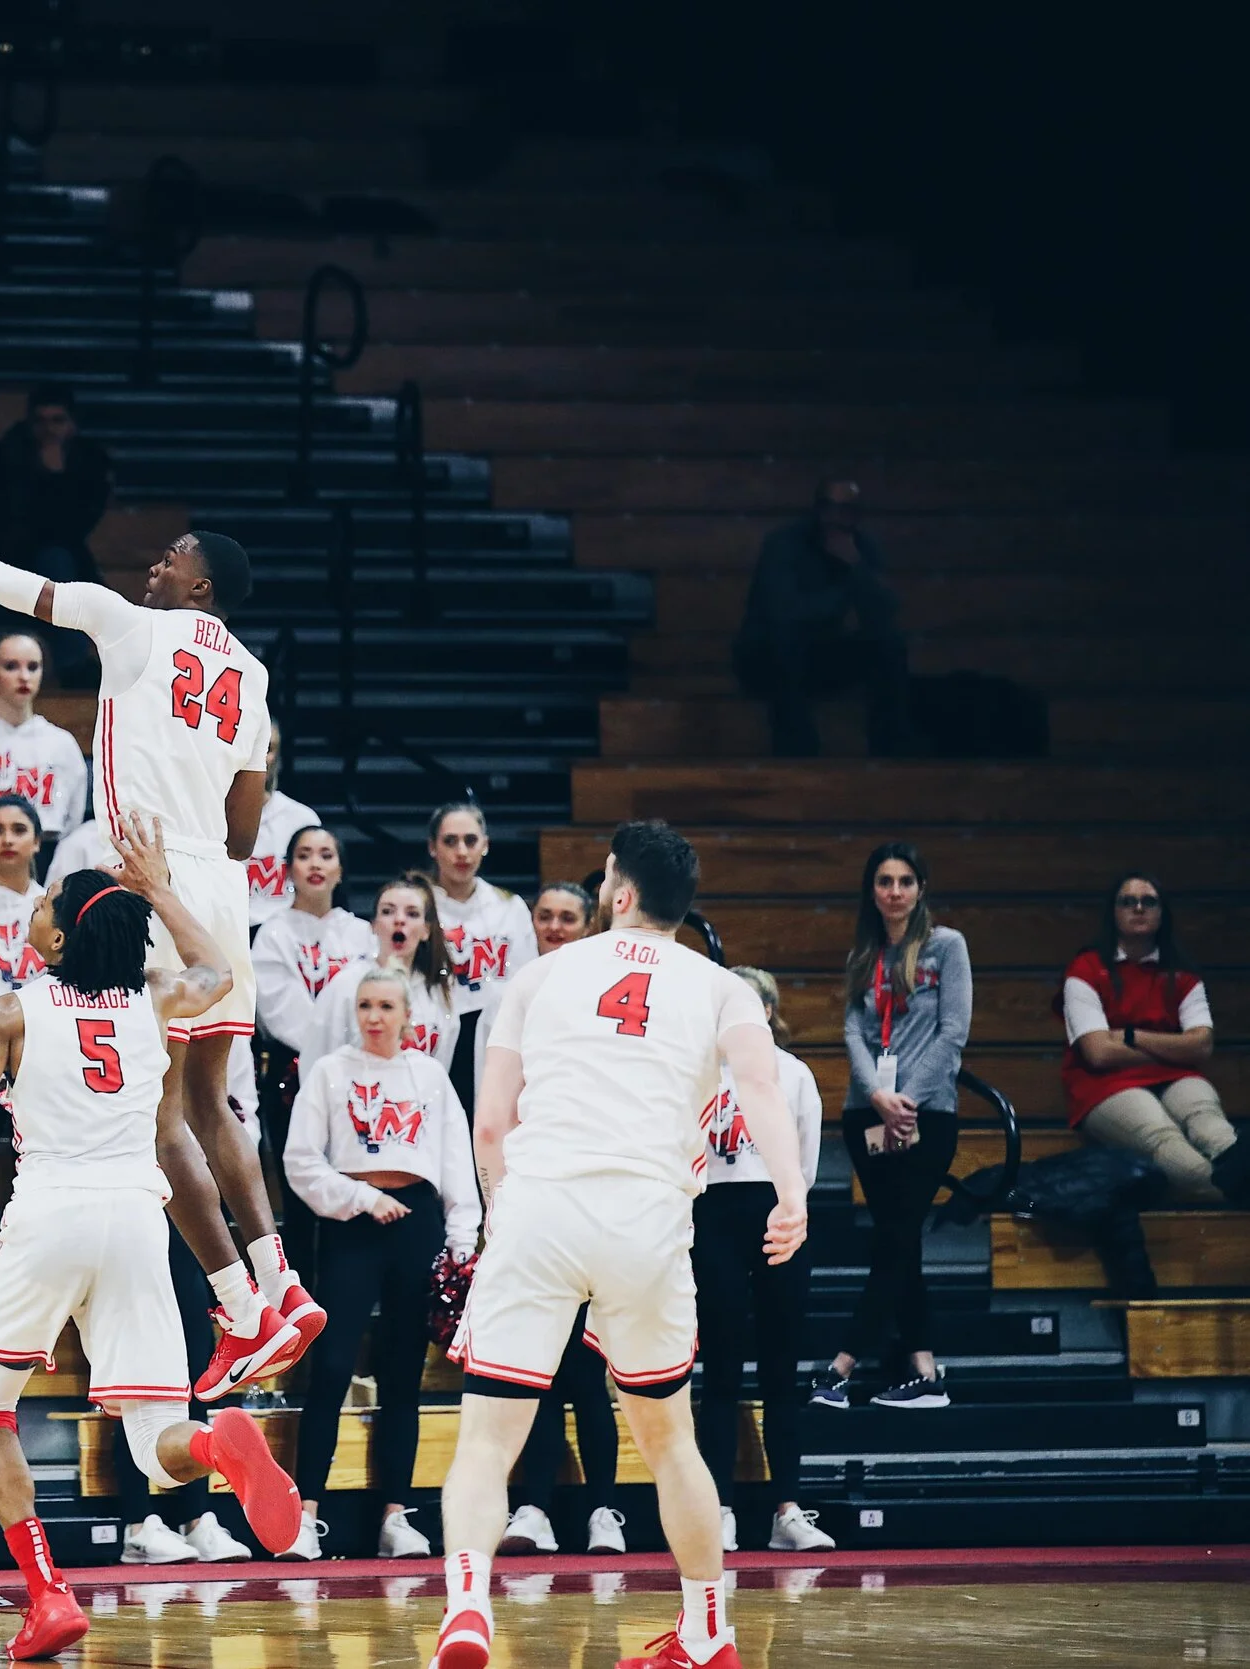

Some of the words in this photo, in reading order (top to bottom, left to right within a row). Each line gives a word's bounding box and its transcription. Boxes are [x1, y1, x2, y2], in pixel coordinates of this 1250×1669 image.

[193, 618, 232, 655] BELL
[171, 649, 243, 745] 24
[597, 972, 652, 1038] 4
[76, 1018, 125, 1093] 5
